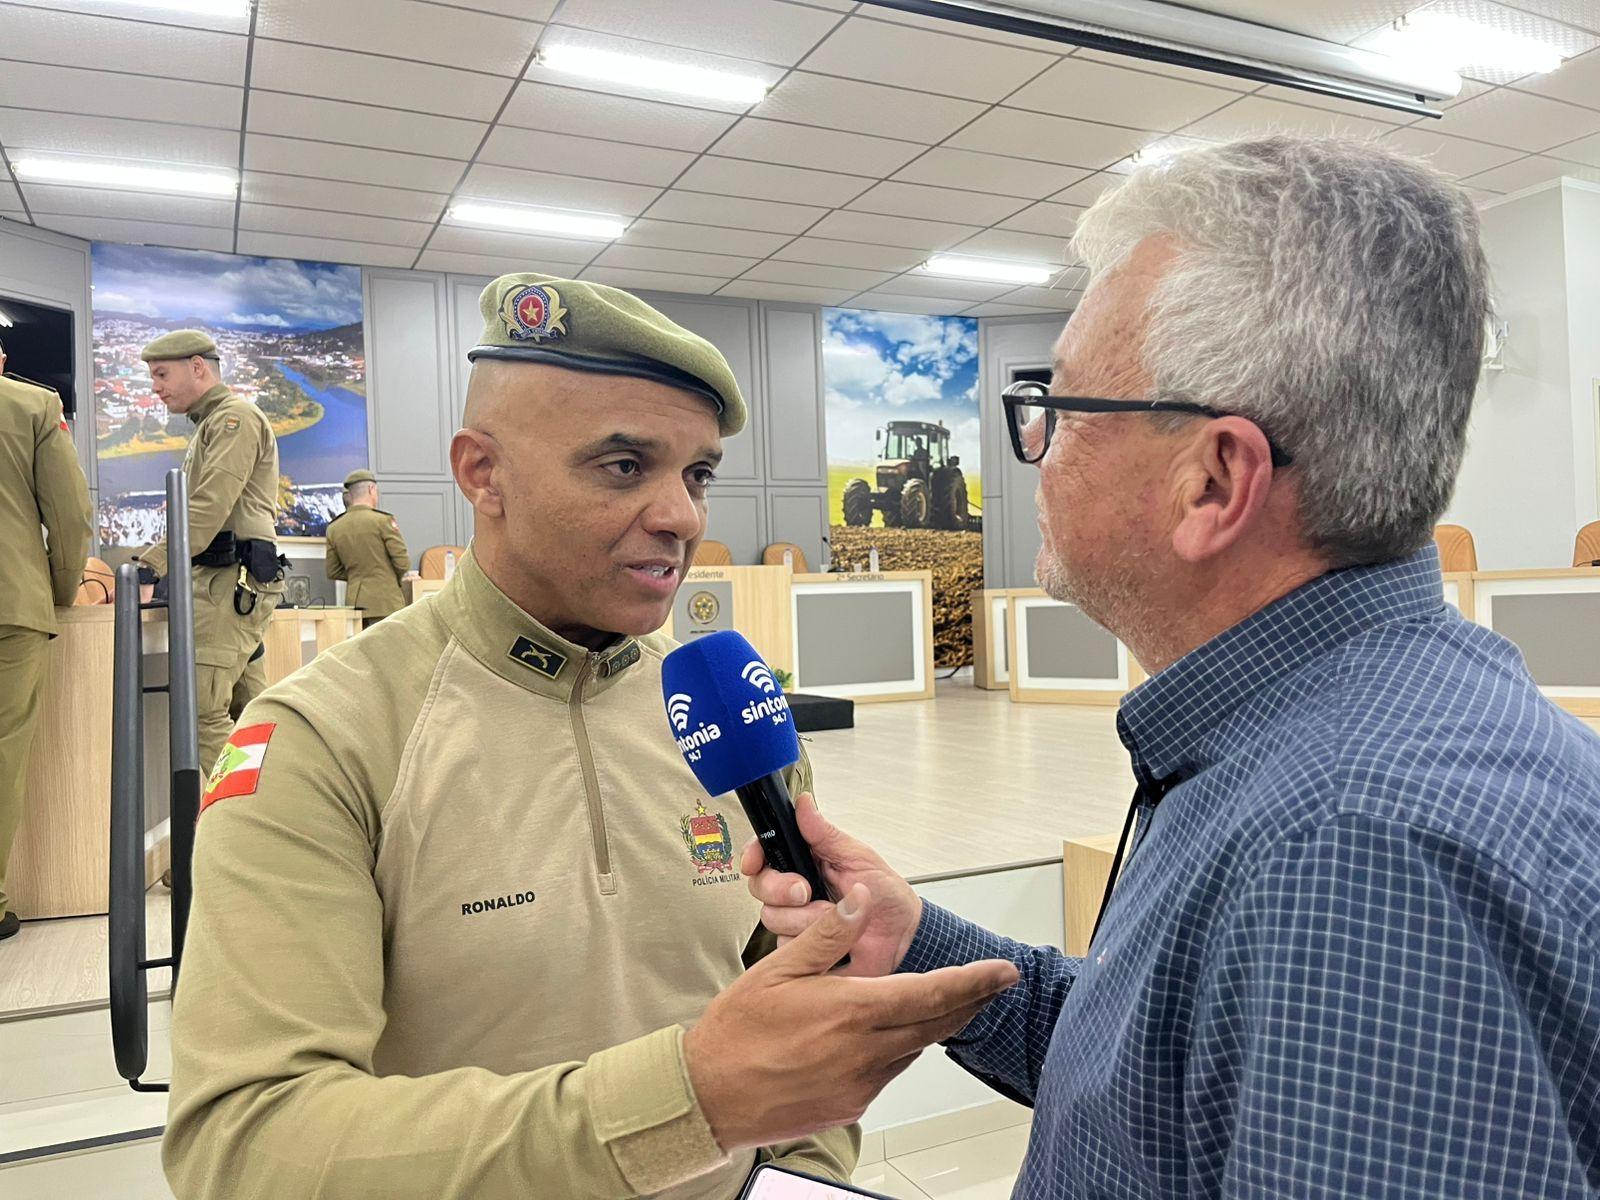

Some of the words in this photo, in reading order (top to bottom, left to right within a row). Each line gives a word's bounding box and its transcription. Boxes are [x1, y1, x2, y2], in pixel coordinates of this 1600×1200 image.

[687, 569, 724, 579] esidente
[741, 695, 789, 724] sinton
[677, 722, 721, 753] ntonia
[692, 875, 719, 886] POLÍCIA
[719, 872, 741, 883] MILITAR
[461, 891, 536, 916] RONALDO
